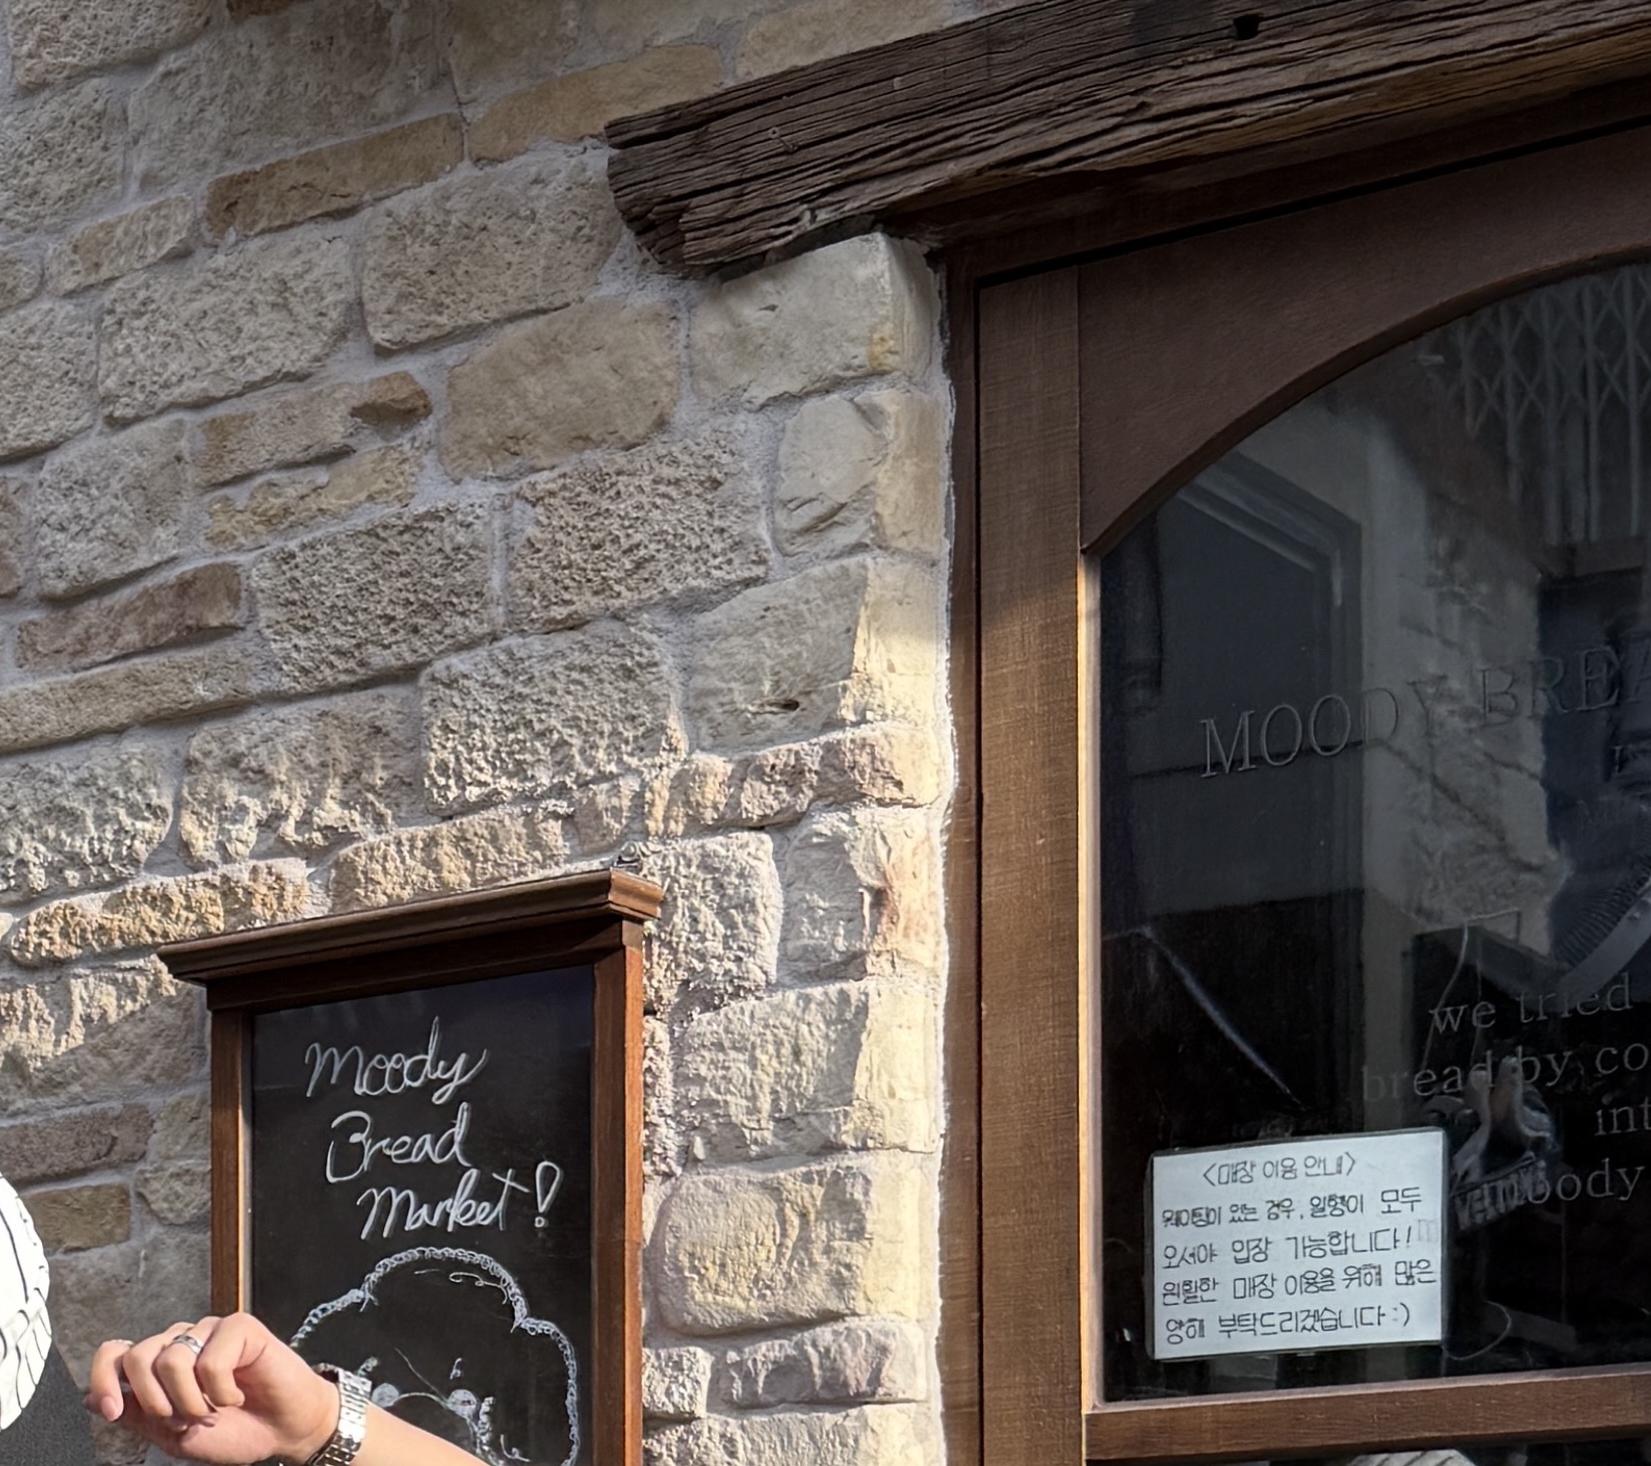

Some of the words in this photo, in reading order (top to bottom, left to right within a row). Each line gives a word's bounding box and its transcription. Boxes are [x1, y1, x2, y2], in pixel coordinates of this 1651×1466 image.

[1199, 675, 1448, 778] MOODY
[1428, 1000, 1496, 1034] we
[1518, 972, 1634, 1023] tried
[305, 1016, 489, 1104] Moody
[1362, 1050, 1494, 1100] bread
[1517, 1045, 1571, 1086] by
[325, 1102, 472, 1183] Bread
[1262, 1157, 1298, 1180] 이용
[1229, 1203, 1259, 1224] 있는
[1309, 1194, 1364, 1218] 일행이
[1380, 1187, 1423, 1215] 모두
[1232, 1237, 1273, 1265] 입장
[1162, 1276, 1219, 1306] 원활한
[1233, 1273, 1278, 1300] 매장
[1284, 1267, 1336, 1295] 이용을
[1342, 1264, 1383, 1288] 위해
[1395, 1259, 1437, 1286] 많은
[1166, 1317, 1205, 1345] 양해
[1218, 1305, 1386, 1338] 부탁드리겠습니다
